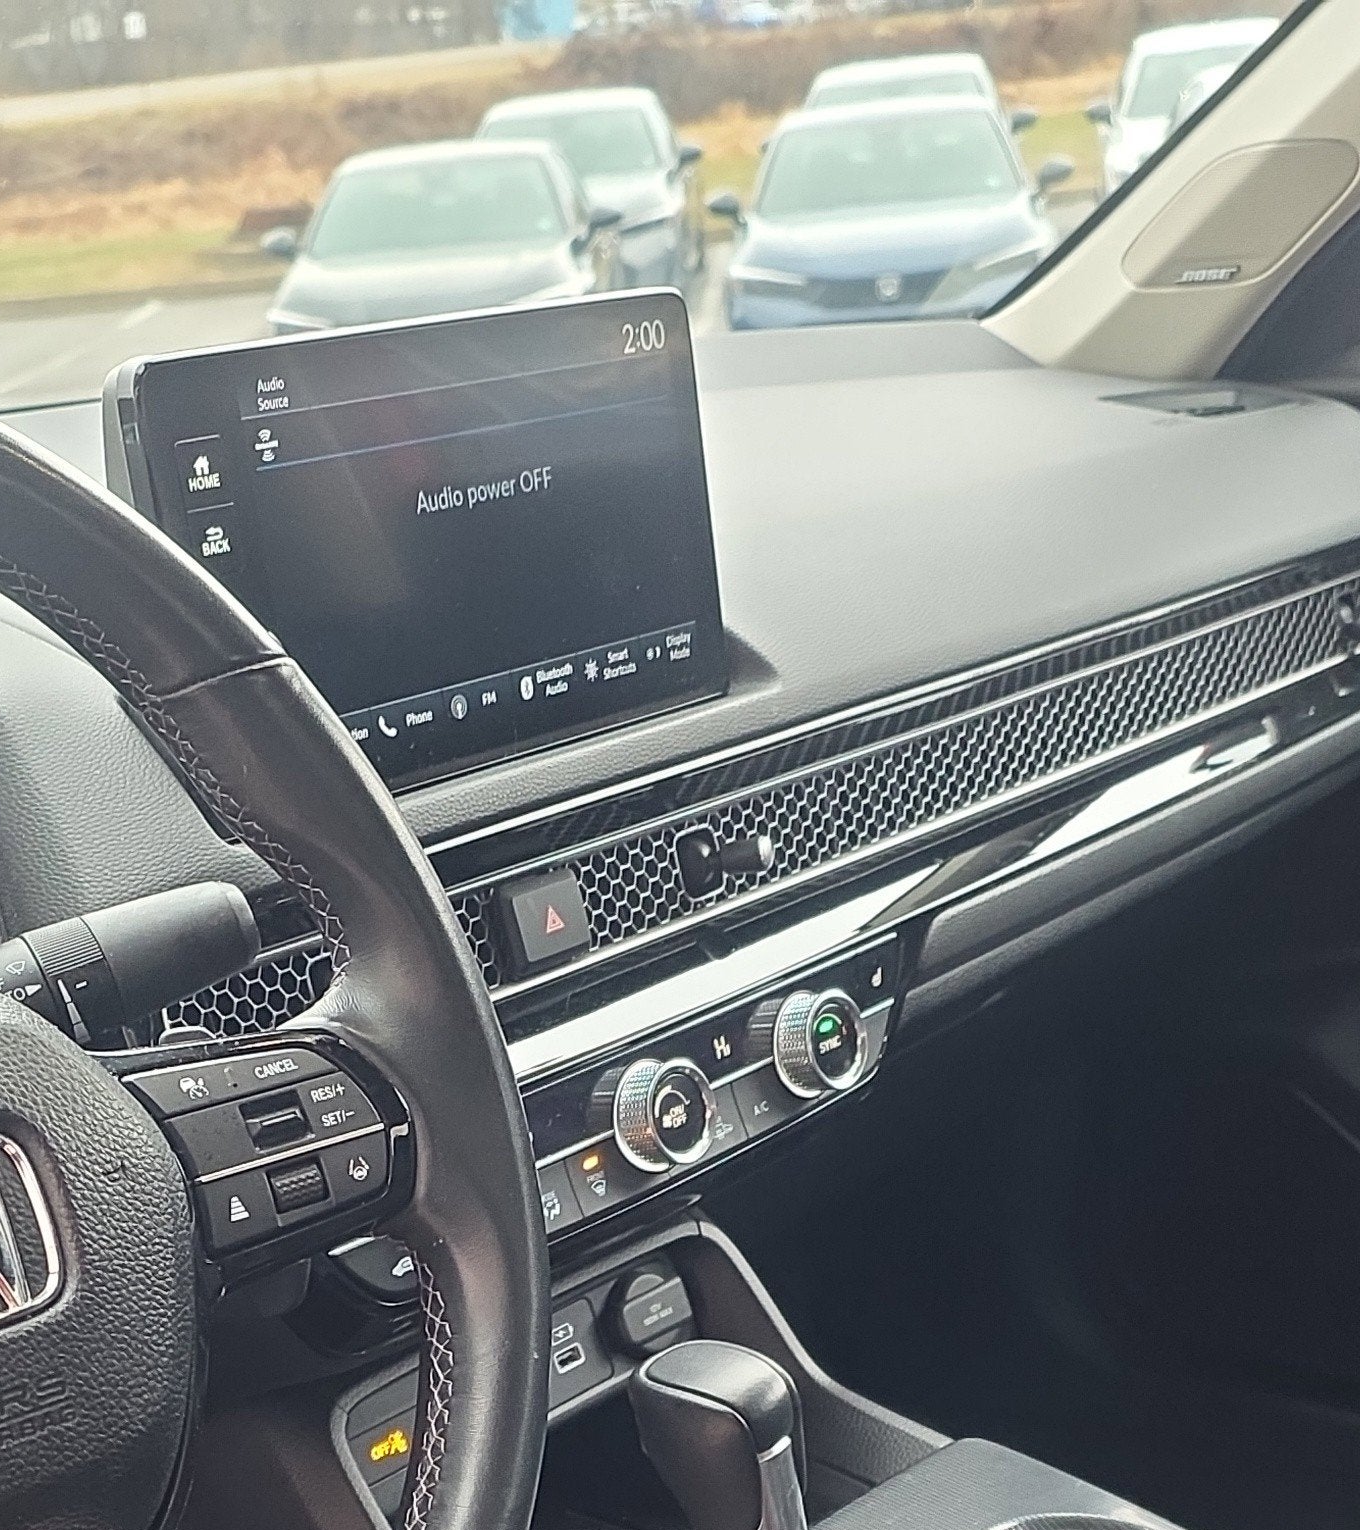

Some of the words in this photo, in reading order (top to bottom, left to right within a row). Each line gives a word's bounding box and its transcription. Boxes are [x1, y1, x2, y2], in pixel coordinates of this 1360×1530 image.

[622, 319, 665, 354] 2:00
[257, 376, 285, 394] Audio
[257, 395, 289, 411] Source
[188, 473, 221, 492] HOME
[416, 485, 464, 515] Audio
[467, 477, 516, 509] power
[519, 466, 552, 493] OFF
[201, 538, 231, 557] BACK
[545, 680, 569, 697] Audio
[481, 690, 498, 707] FM
[405, 710, 434, 727] Phone
[819, 1034, 842, 1055] SYNC
[254, 1058, 299, 1079] CANCEL
[310, 1083, 345, 1103] RES/+
